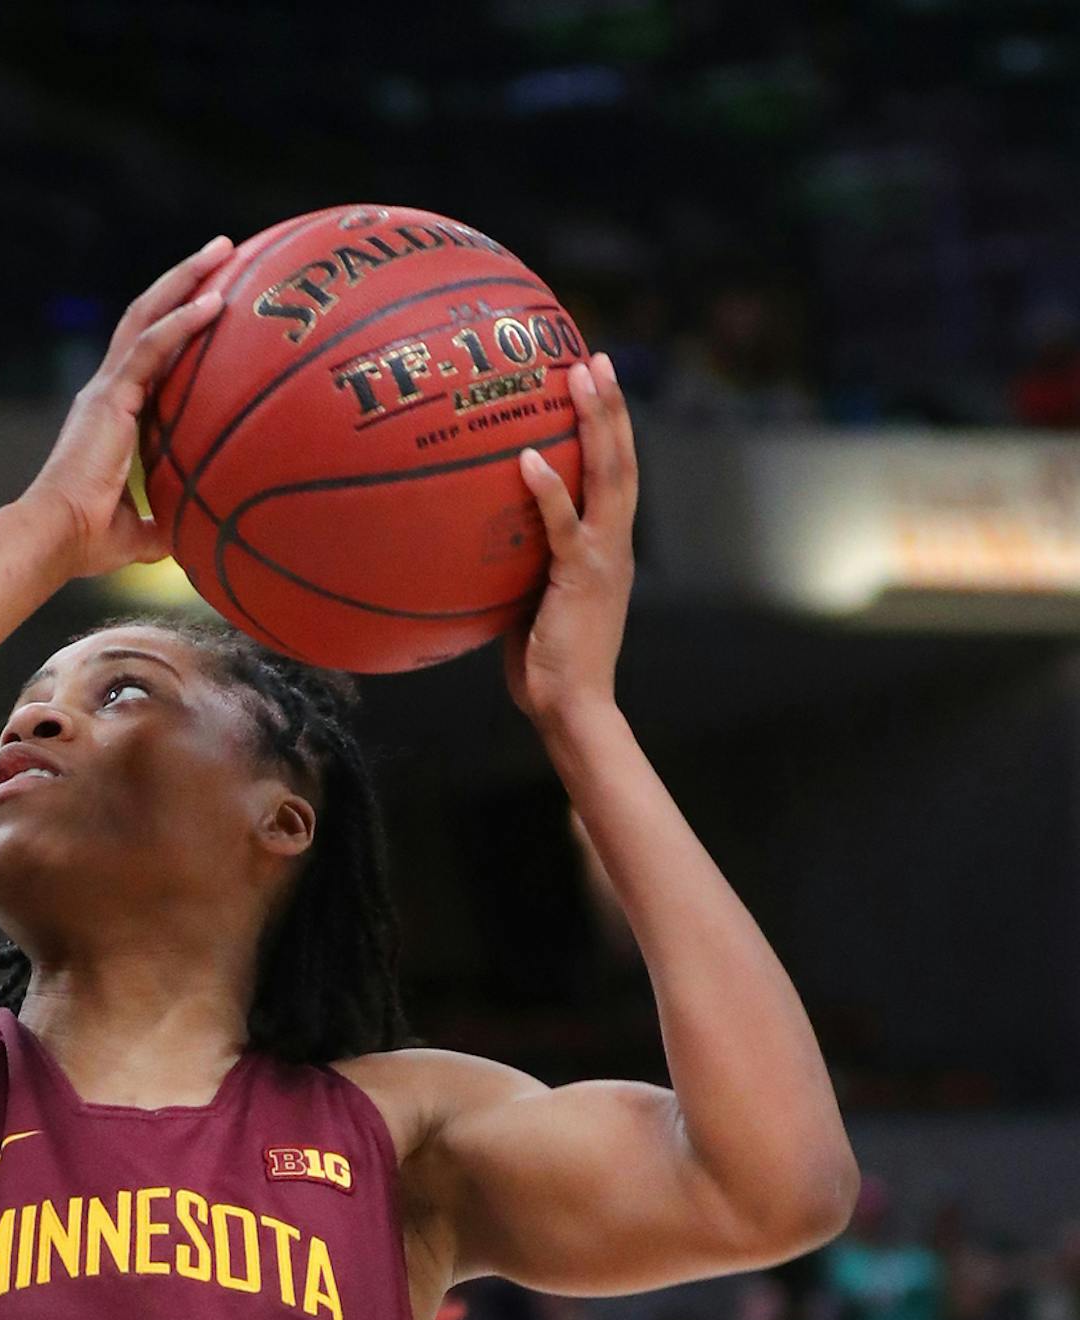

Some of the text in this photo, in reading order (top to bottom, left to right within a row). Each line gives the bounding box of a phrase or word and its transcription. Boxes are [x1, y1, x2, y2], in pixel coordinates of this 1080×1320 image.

[333, 314, 582, 416] TF-1000
[415, 425, 460, 449] DEEP
[467, 403, 538, 432] CHANNEL
